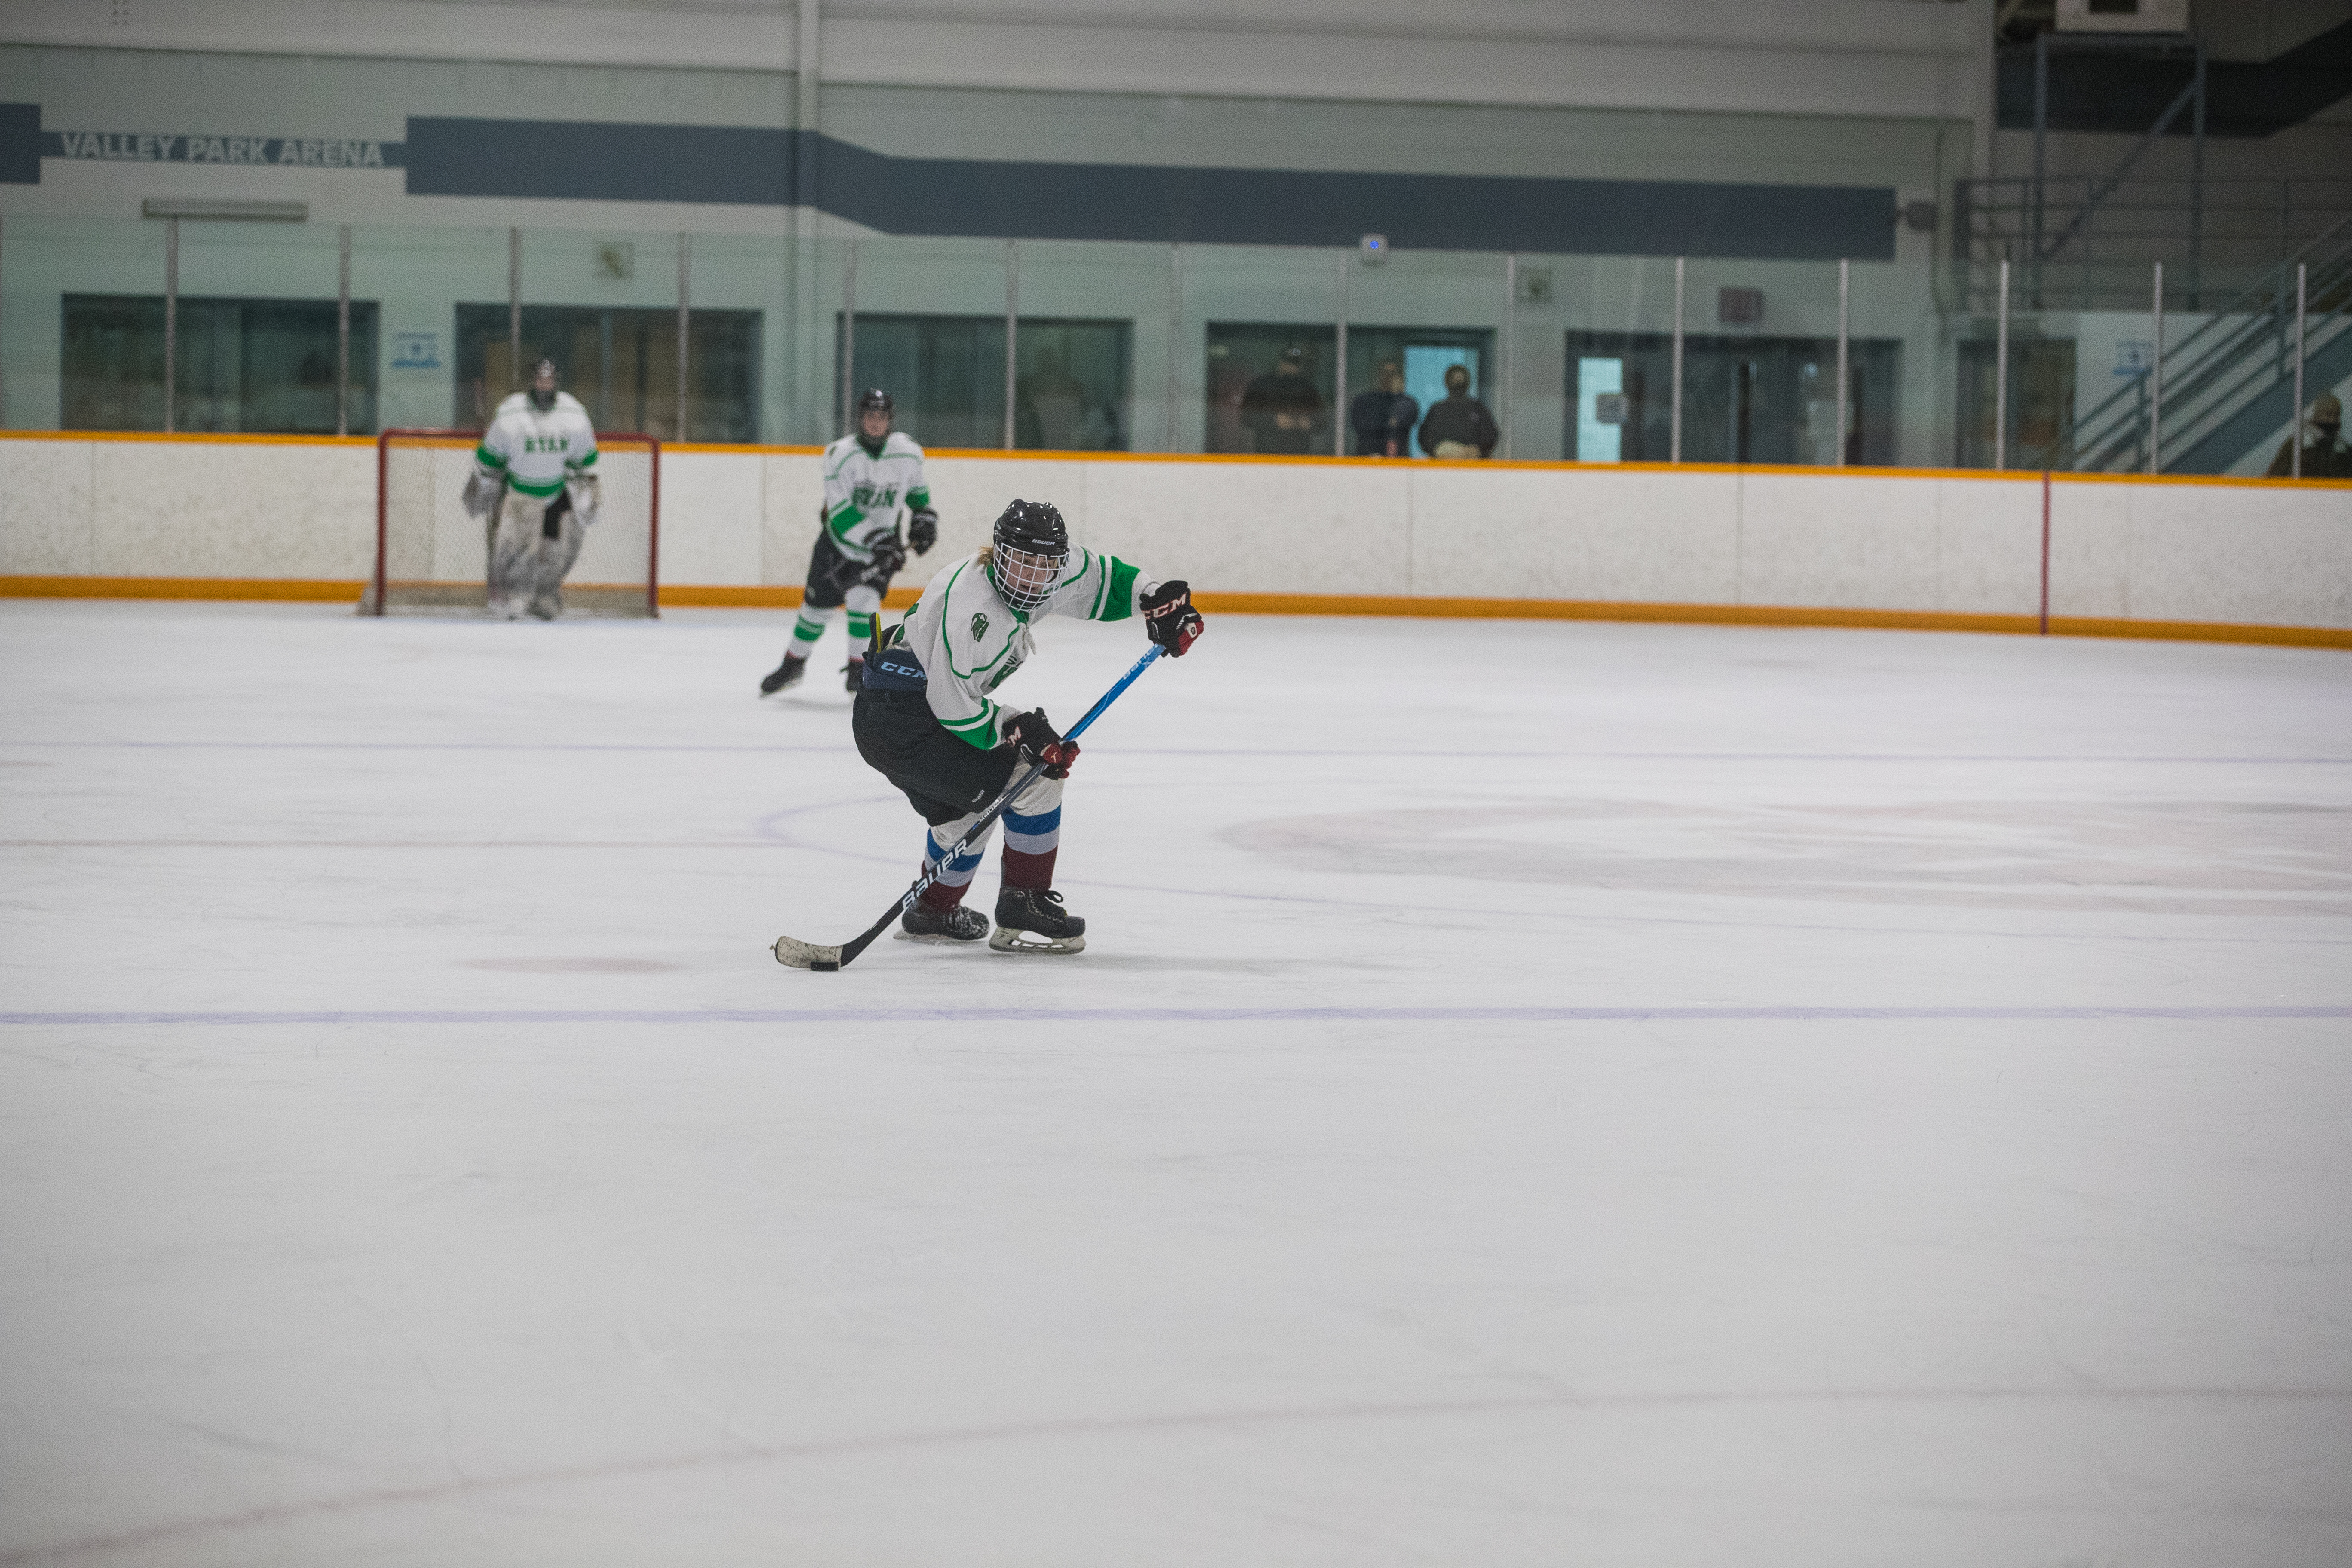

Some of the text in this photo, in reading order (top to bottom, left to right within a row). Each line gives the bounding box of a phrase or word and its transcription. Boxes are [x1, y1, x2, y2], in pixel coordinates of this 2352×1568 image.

[63, 133, 384, 166] VALLEY PARK ARENA
[1142, 593, 1186, 619] CCM
[902, 839, 967, 911] BAUER
